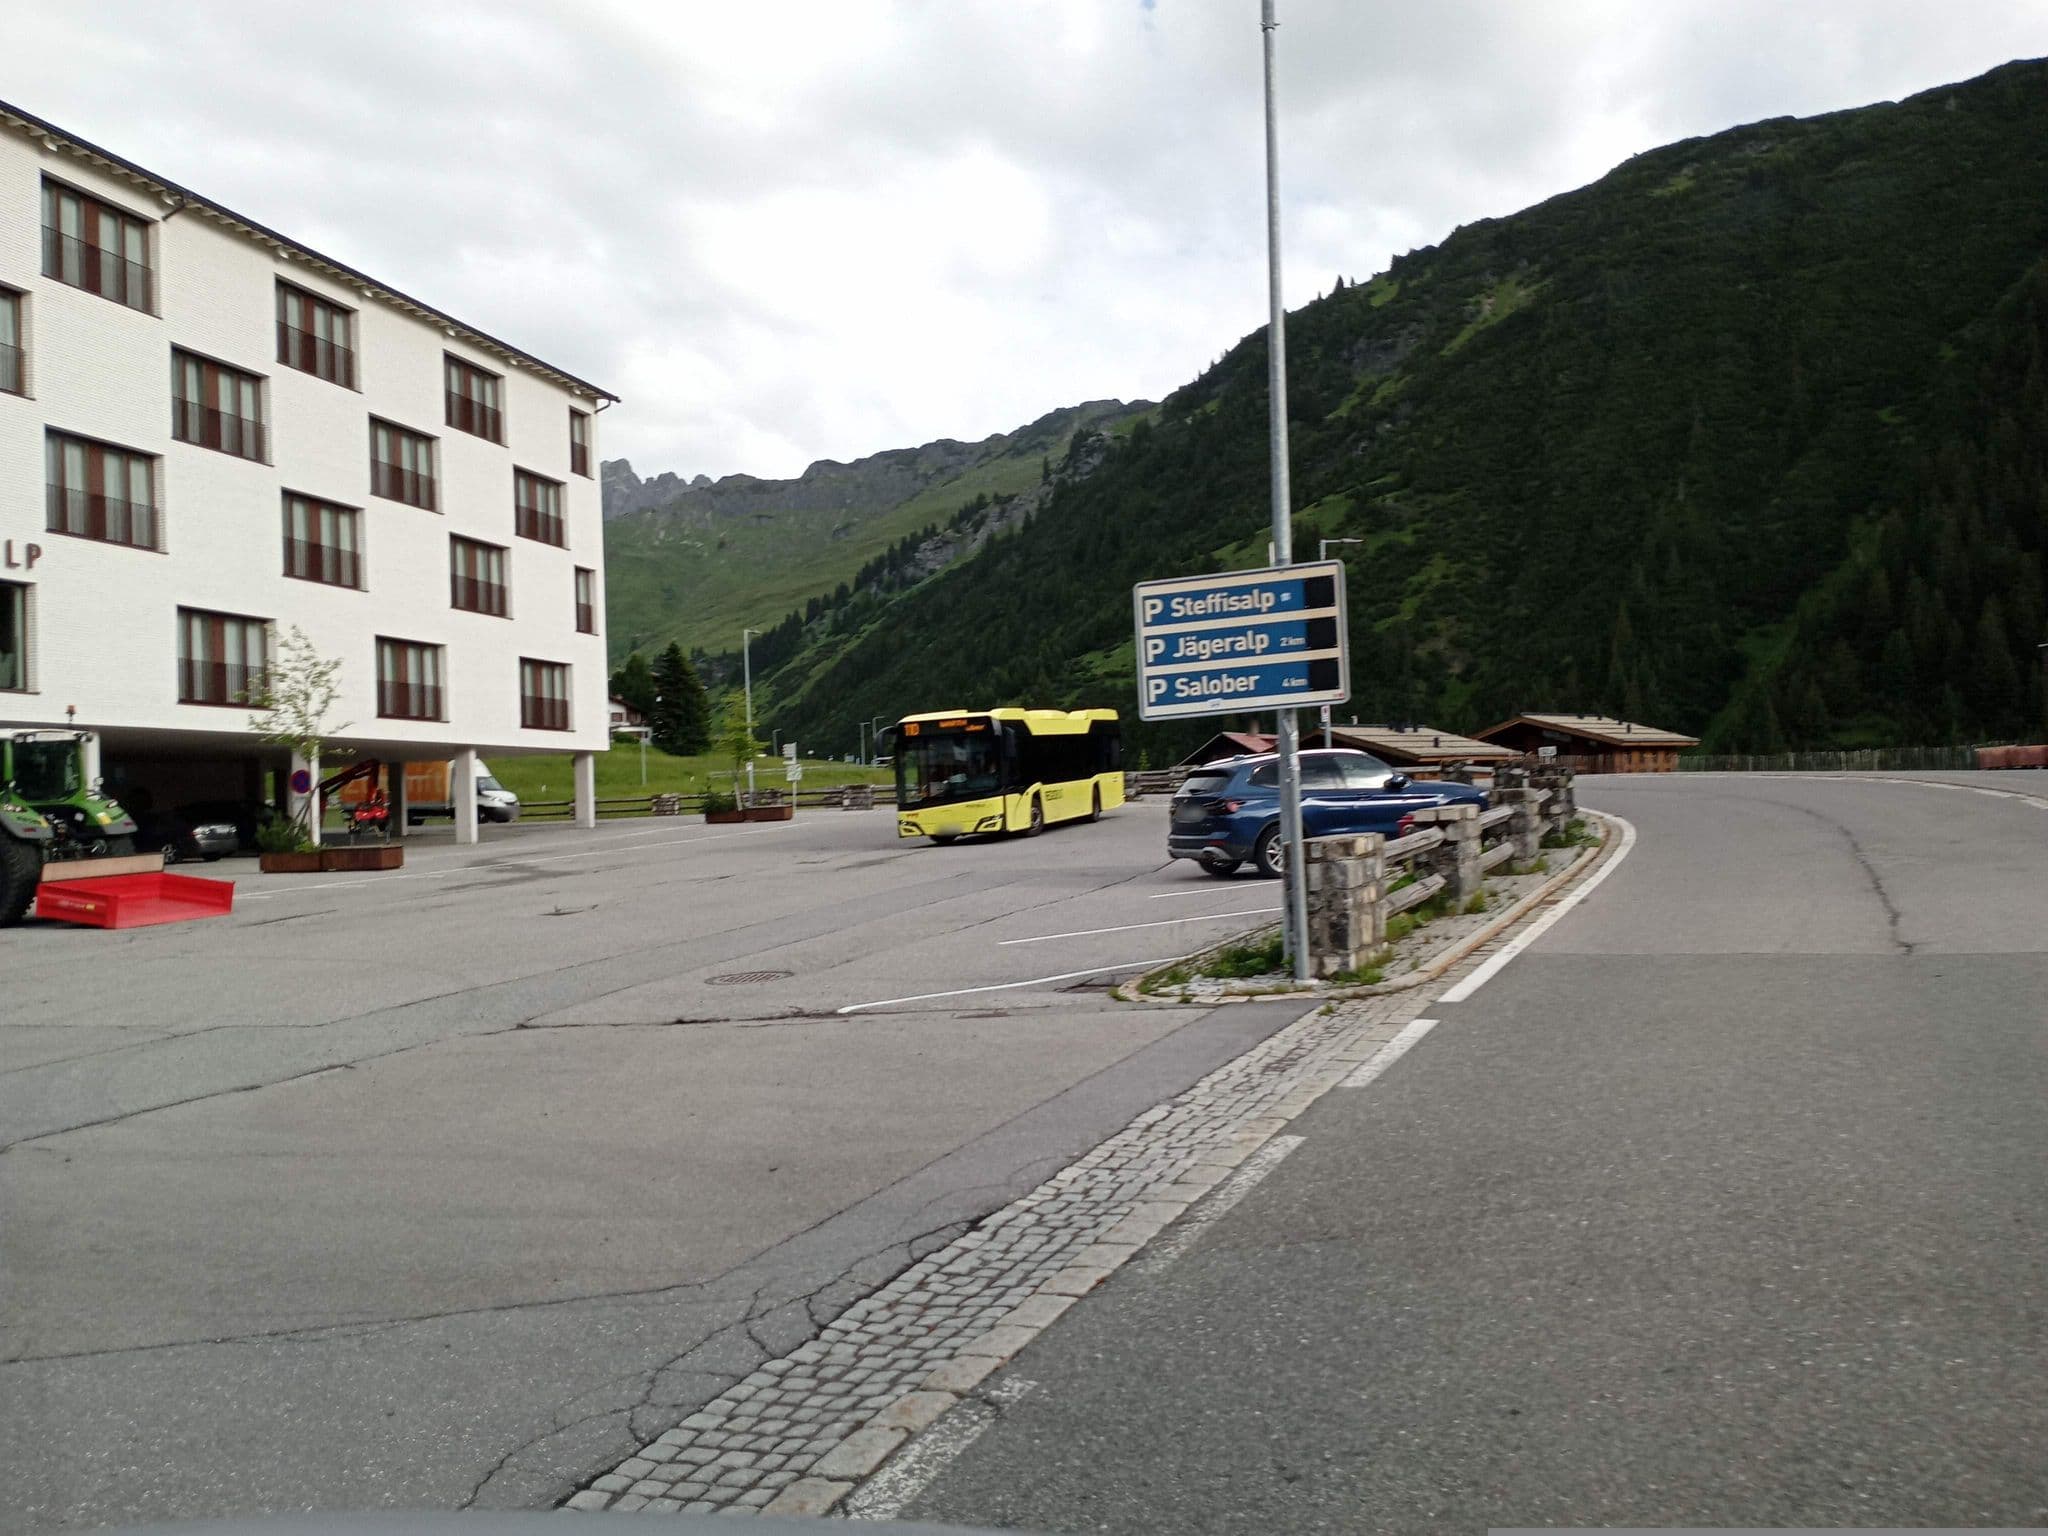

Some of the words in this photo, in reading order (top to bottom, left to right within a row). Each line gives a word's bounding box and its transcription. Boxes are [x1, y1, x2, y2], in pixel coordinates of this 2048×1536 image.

[1143, 598, 1164, 623] P
[1170, 589, 1276, 618] Steffisalp
[1146, 638, 1166, 663] P
[1173, 630, 1270, 660] Jägeralp
[1148, 678, 1168, 703] P
[1175, 673, 1261, 698] Salober
